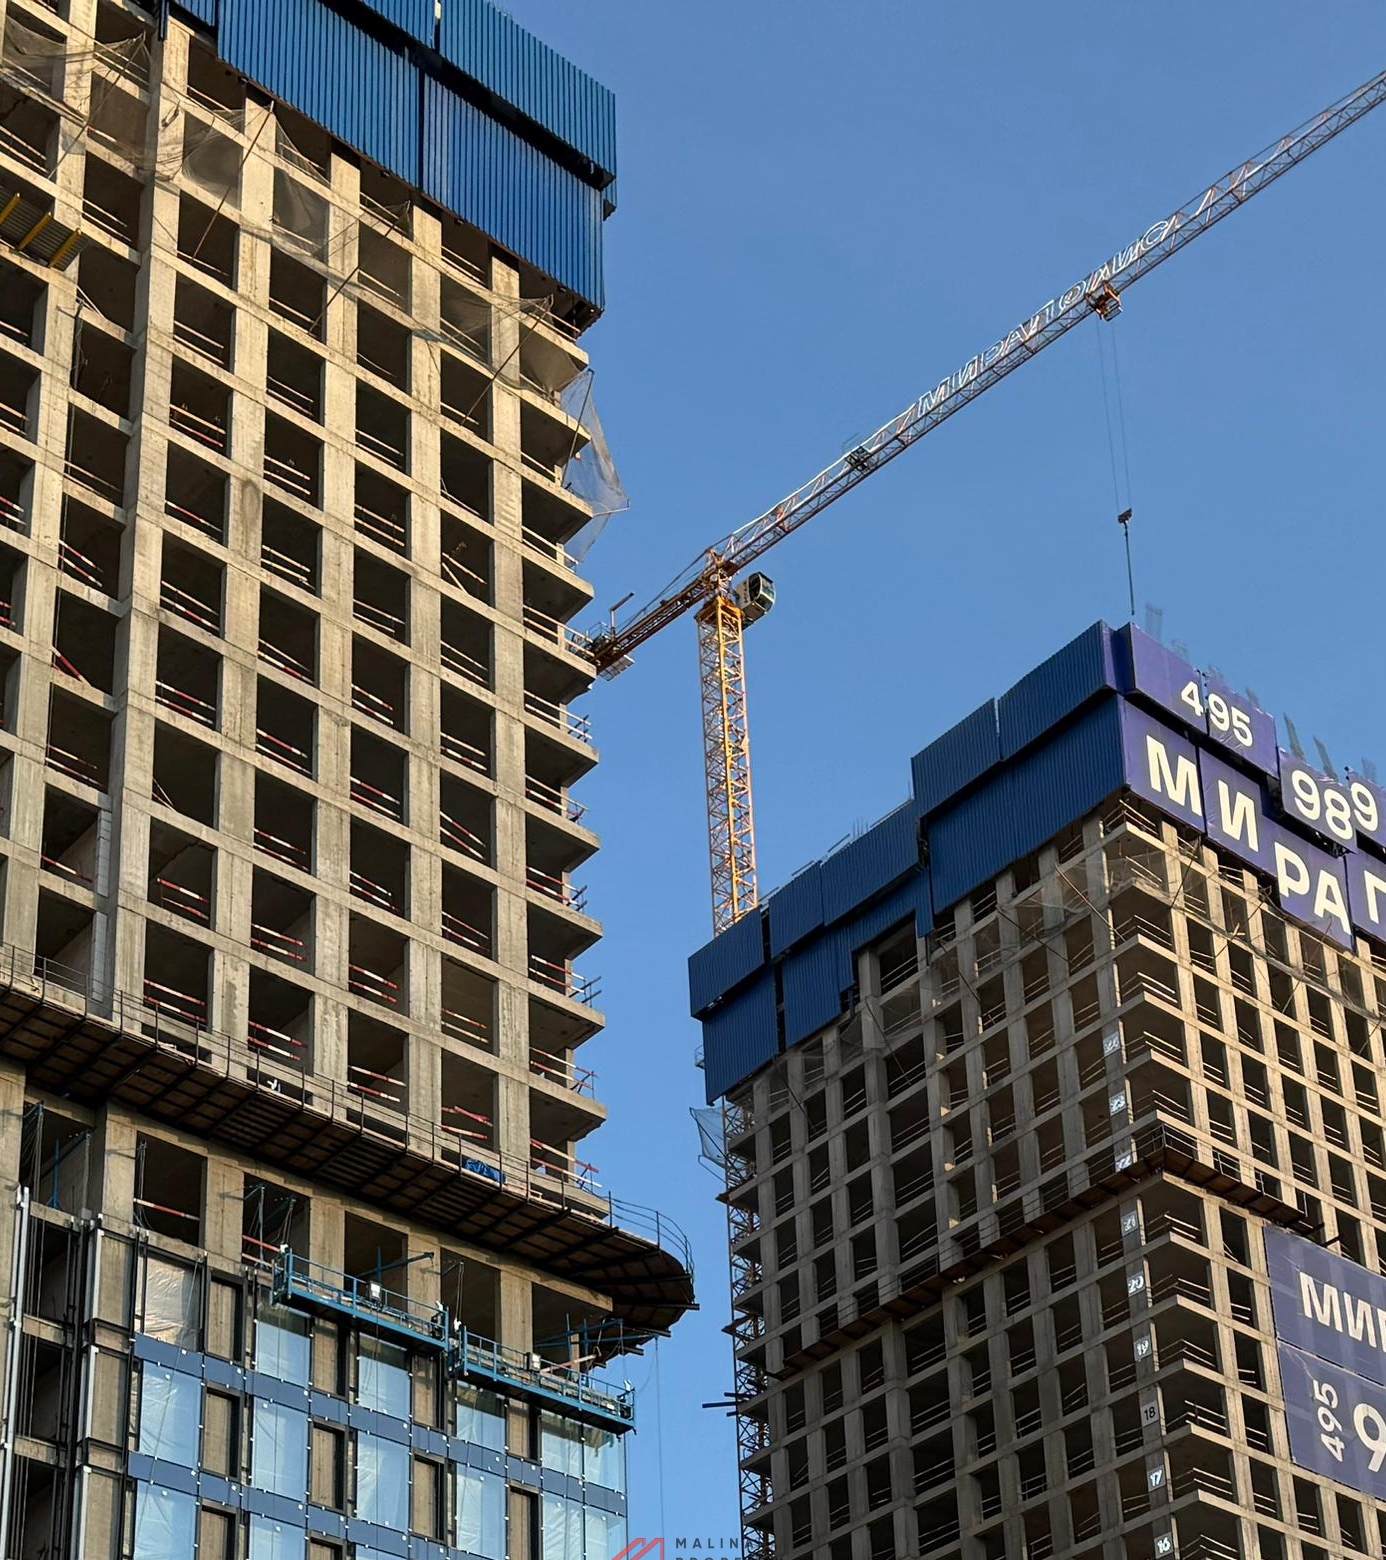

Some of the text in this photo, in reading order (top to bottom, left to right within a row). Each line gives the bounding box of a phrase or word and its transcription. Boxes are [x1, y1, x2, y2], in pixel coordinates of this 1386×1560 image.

[1181, 681, 1254, 747] 495
[1291, 769, 1379, 841] 989
[1144, 1406, 1156, 1421] 18
[1313, 1380, 1346, 1462] 495
[1150, 1469, 1163, 1487] 17
